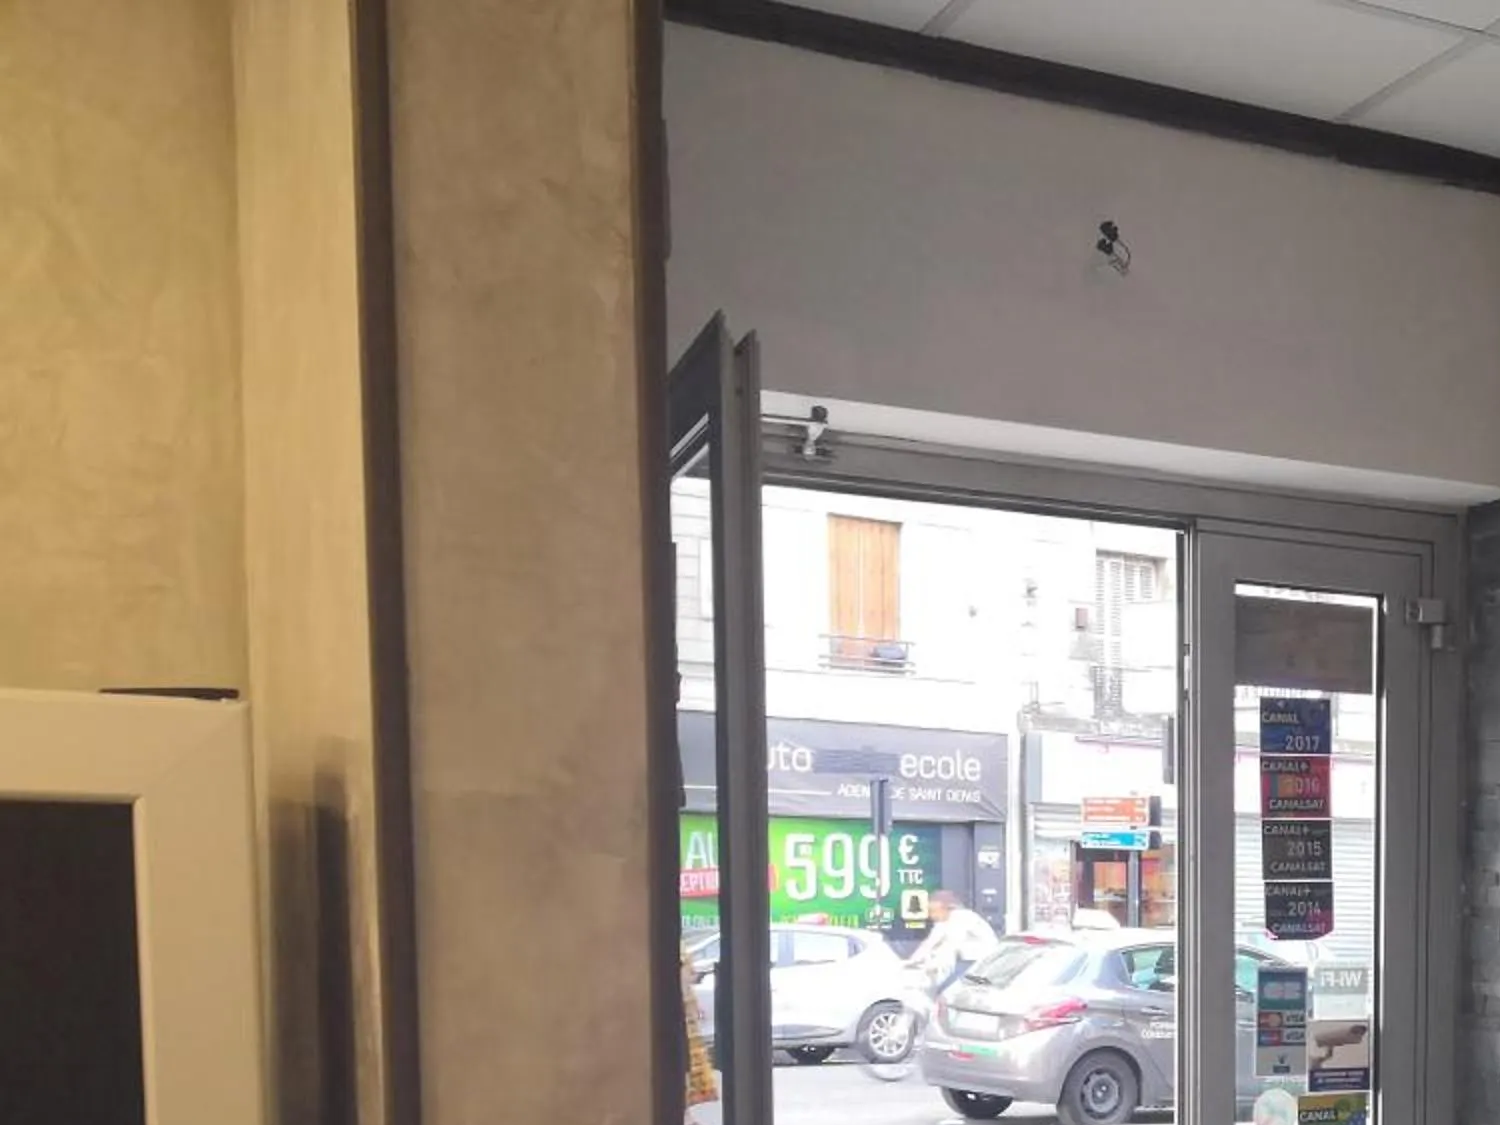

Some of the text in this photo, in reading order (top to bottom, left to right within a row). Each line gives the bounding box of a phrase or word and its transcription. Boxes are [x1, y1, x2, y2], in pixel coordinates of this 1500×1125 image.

[1285, 735, 1320, 752] 2017
[900, 749, 982, 783] ecole
[1287, 841, 1322, 857] 2015
[784, 832, 891, 901] 599
[897, 869, 924, 885] TTC
[1287, 901, 1322, 917] 2014
